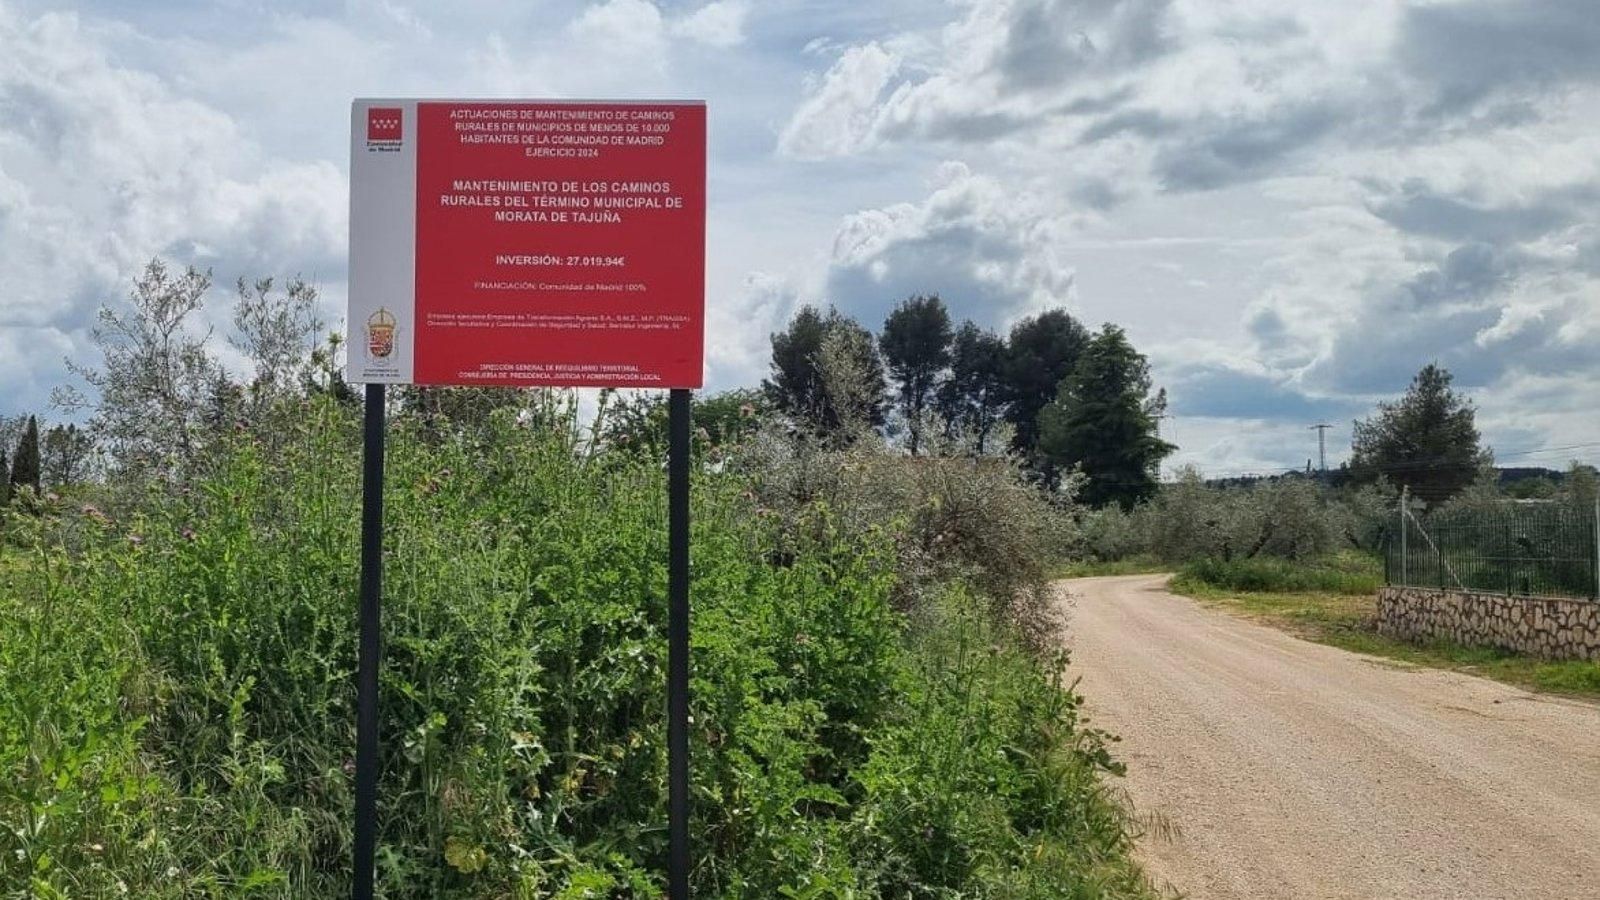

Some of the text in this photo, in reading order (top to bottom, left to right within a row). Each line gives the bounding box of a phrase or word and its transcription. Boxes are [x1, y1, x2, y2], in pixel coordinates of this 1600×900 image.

[450, 110, 675, 120] ACTUACIONES DE MANTENIMIENTO DE CAMINOS
[502, 123, 515, 131] DE
[517, 123, 572, 131] MUNICIPIOS
[574, 123, 587, 131] DE
[626, 124, 639, 132] DE
[641, 124, 670, 132] 10.000
[461, 135, 664, 145] HABITANTES DE LA COMUNIDAD DE MADRID
[525, 148, 598, 157] EJERCICIO 2024
[453, 181, 670, 192] MANTENIMIENTO DE LOS CAMINOS
[441, 194, 683, 207] RURALES DEL TÉRMINO MUNICIPAL DE
[495, 210, 621, 222] MORATA DE TAJUÑA
[496, 254, 563, 264] INVERSIÓN:
